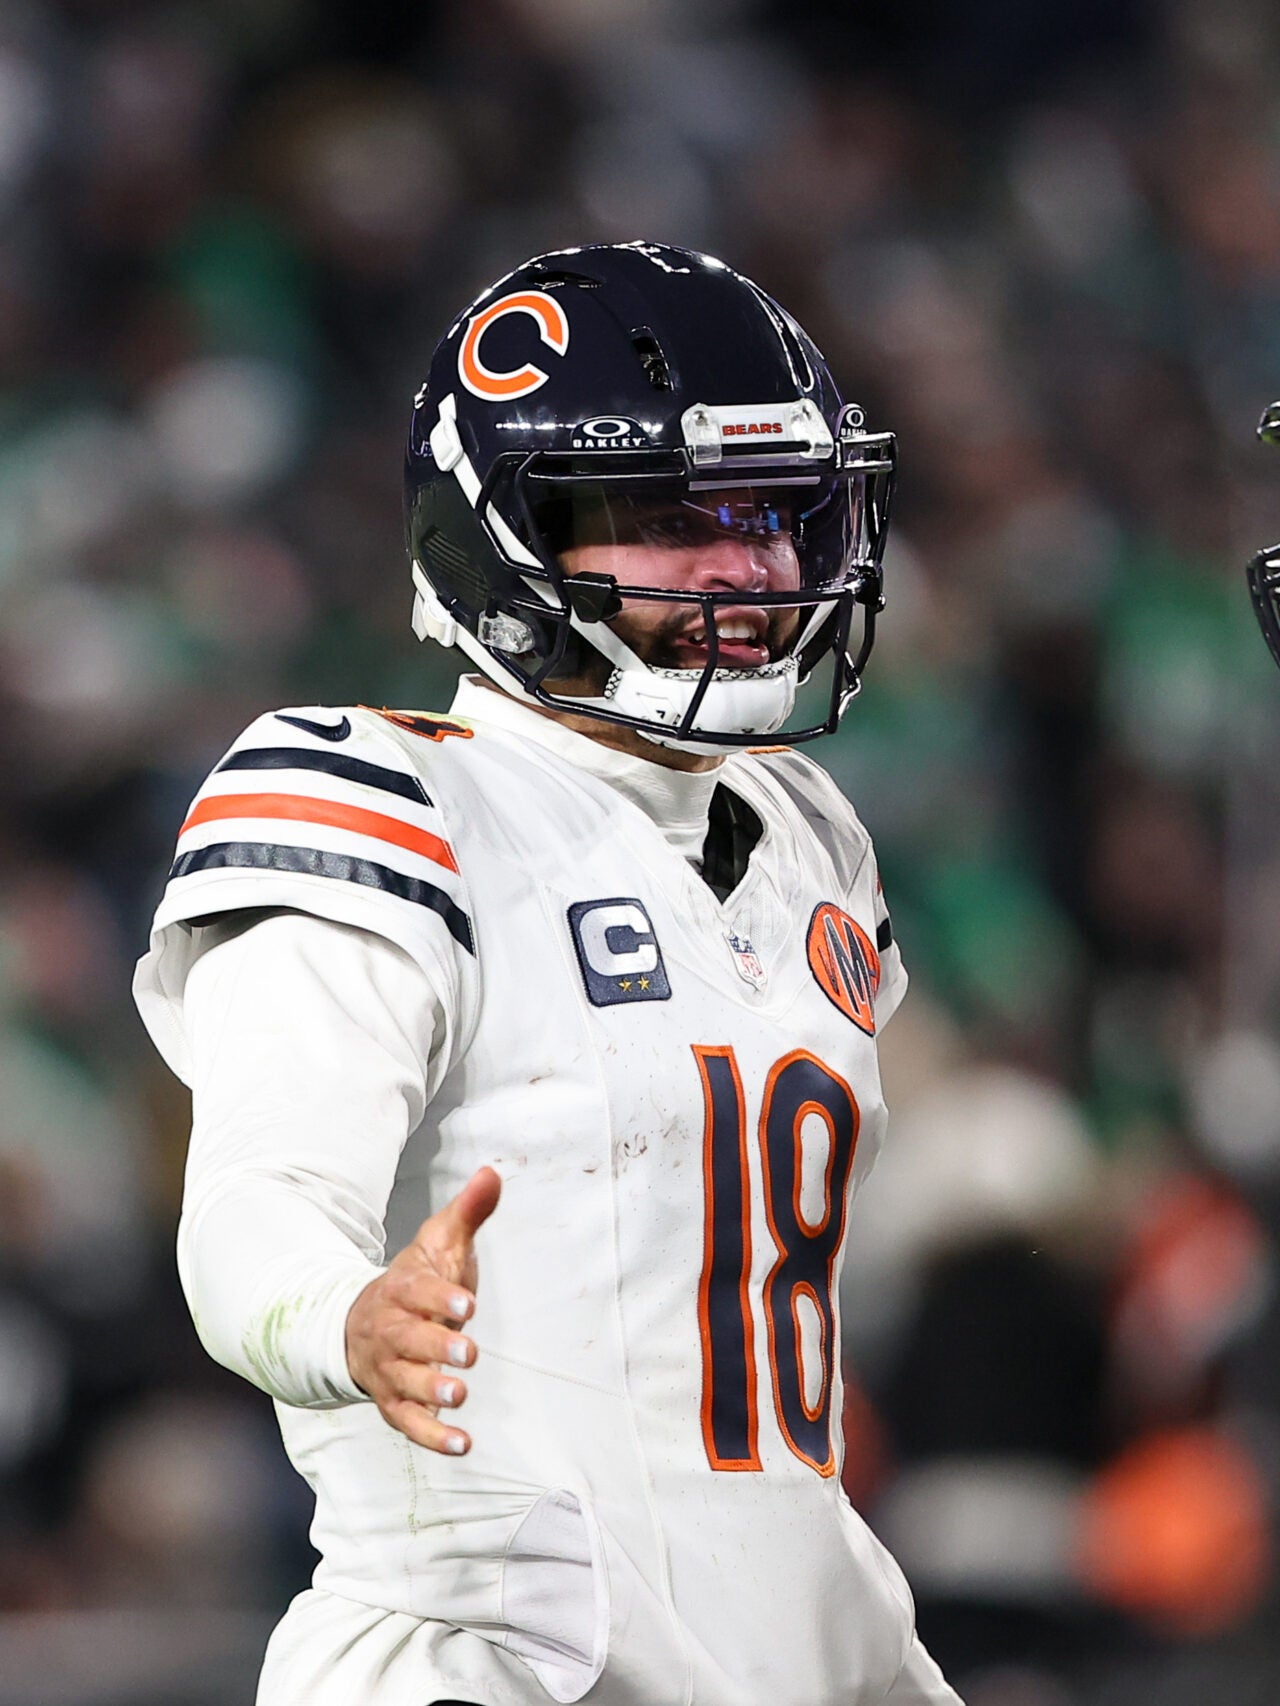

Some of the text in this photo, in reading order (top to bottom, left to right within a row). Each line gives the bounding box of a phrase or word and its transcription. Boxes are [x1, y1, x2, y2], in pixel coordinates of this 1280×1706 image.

[456, 290, 570, 402] C
[572, 437, 644, 449] OAKLEY
[722, 422, 783, 436] BEARS
[578, 904, 659, 978] C
[690, 1043, 861, 1479] 18
